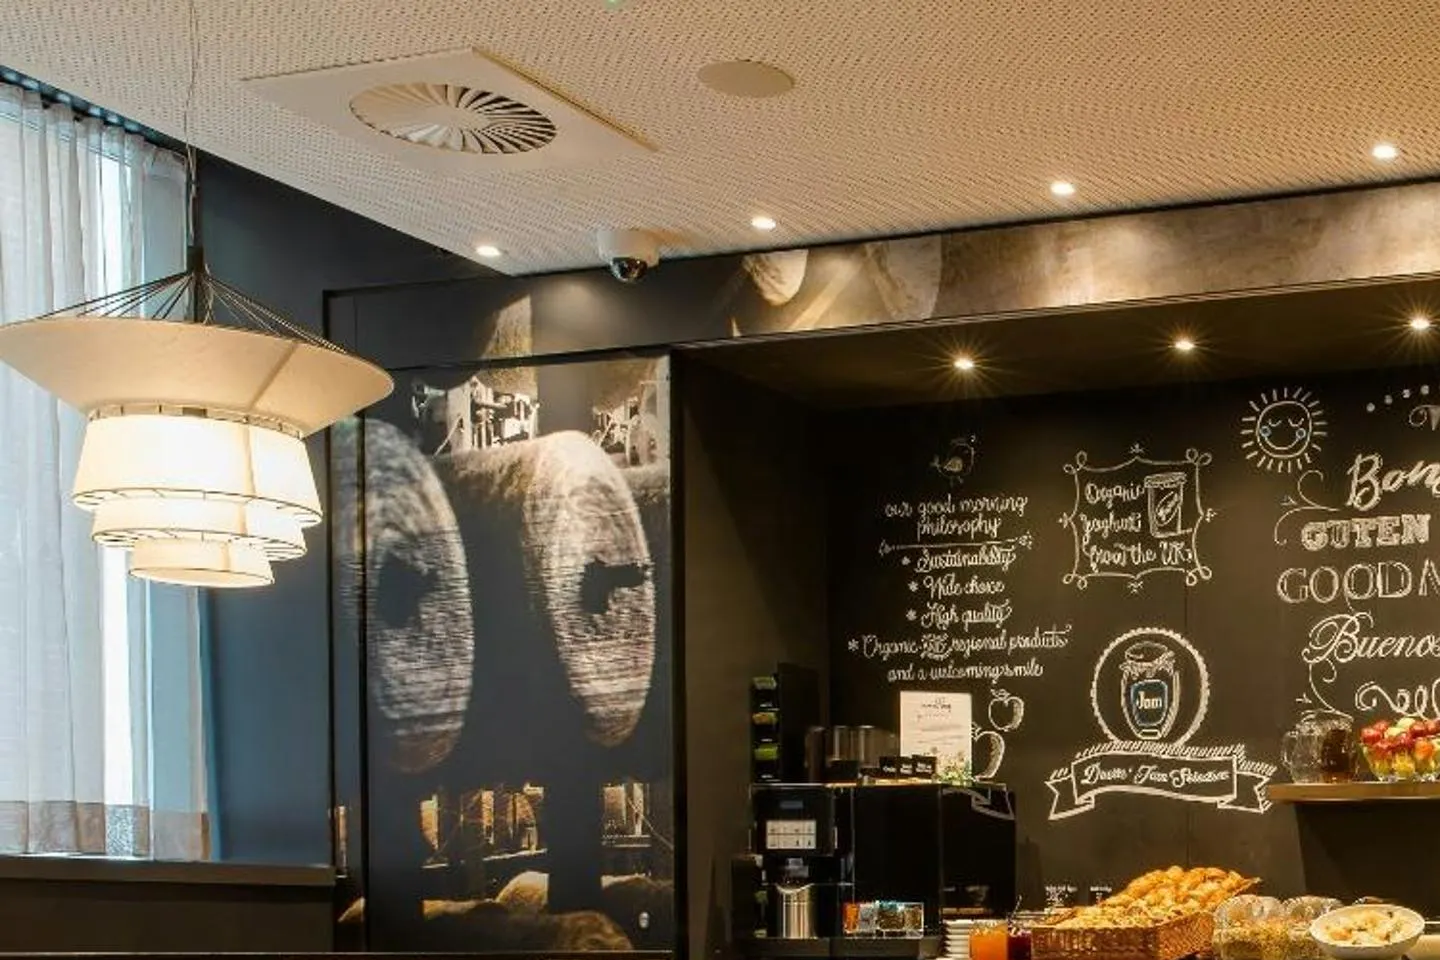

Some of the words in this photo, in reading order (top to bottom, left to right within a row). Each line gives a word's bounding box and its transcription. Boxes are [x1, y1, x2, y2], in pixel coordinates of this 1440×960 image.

[917, 493, 955, 519] good
[959, 497, 1028, 517] morning
[1300, 513, 1431, 552] GUTEN
[1128, 542, 1157, 565] the
[1276, 560, 1413, 604] GOOD
[888, 662, 915, 682] and
[1136, 690, 1162, 709] Jam
